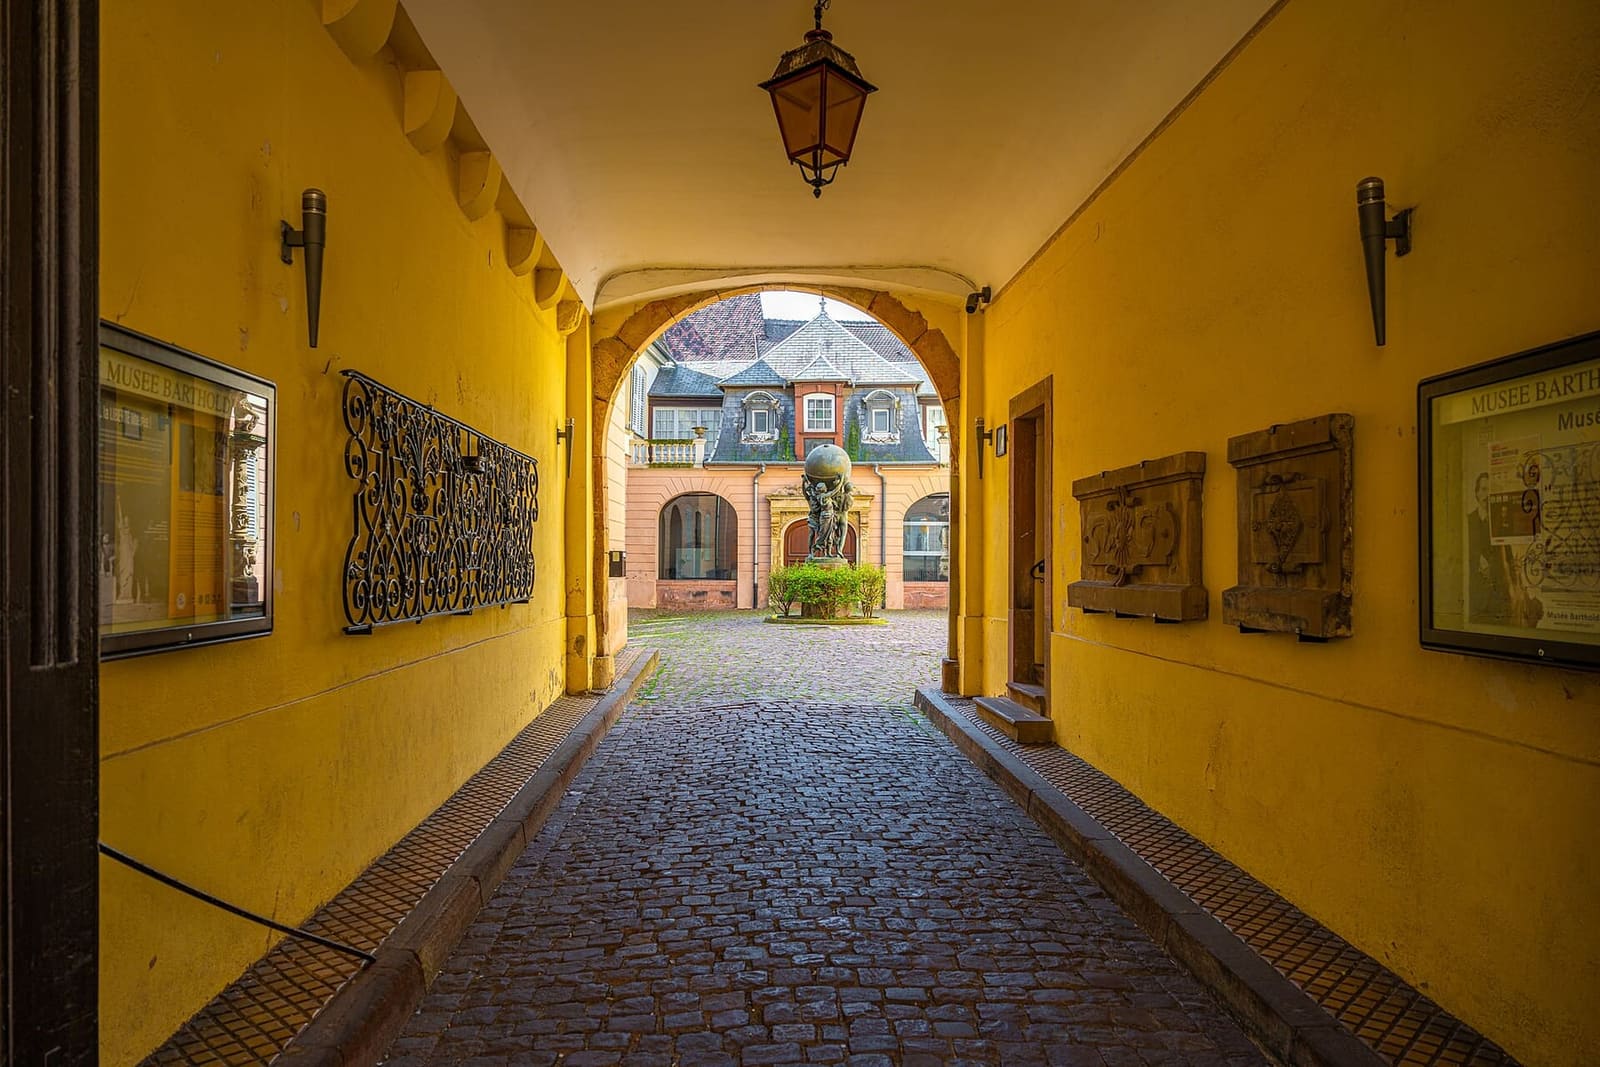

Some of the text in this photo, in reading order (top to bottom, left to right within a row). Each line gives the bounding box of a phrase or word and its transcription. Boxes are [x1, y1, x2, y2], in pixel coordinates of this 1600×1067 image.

[106, 358, 160, 394] MUSEE
[1471, 367, 1600, 415] MUSEE BARTH
